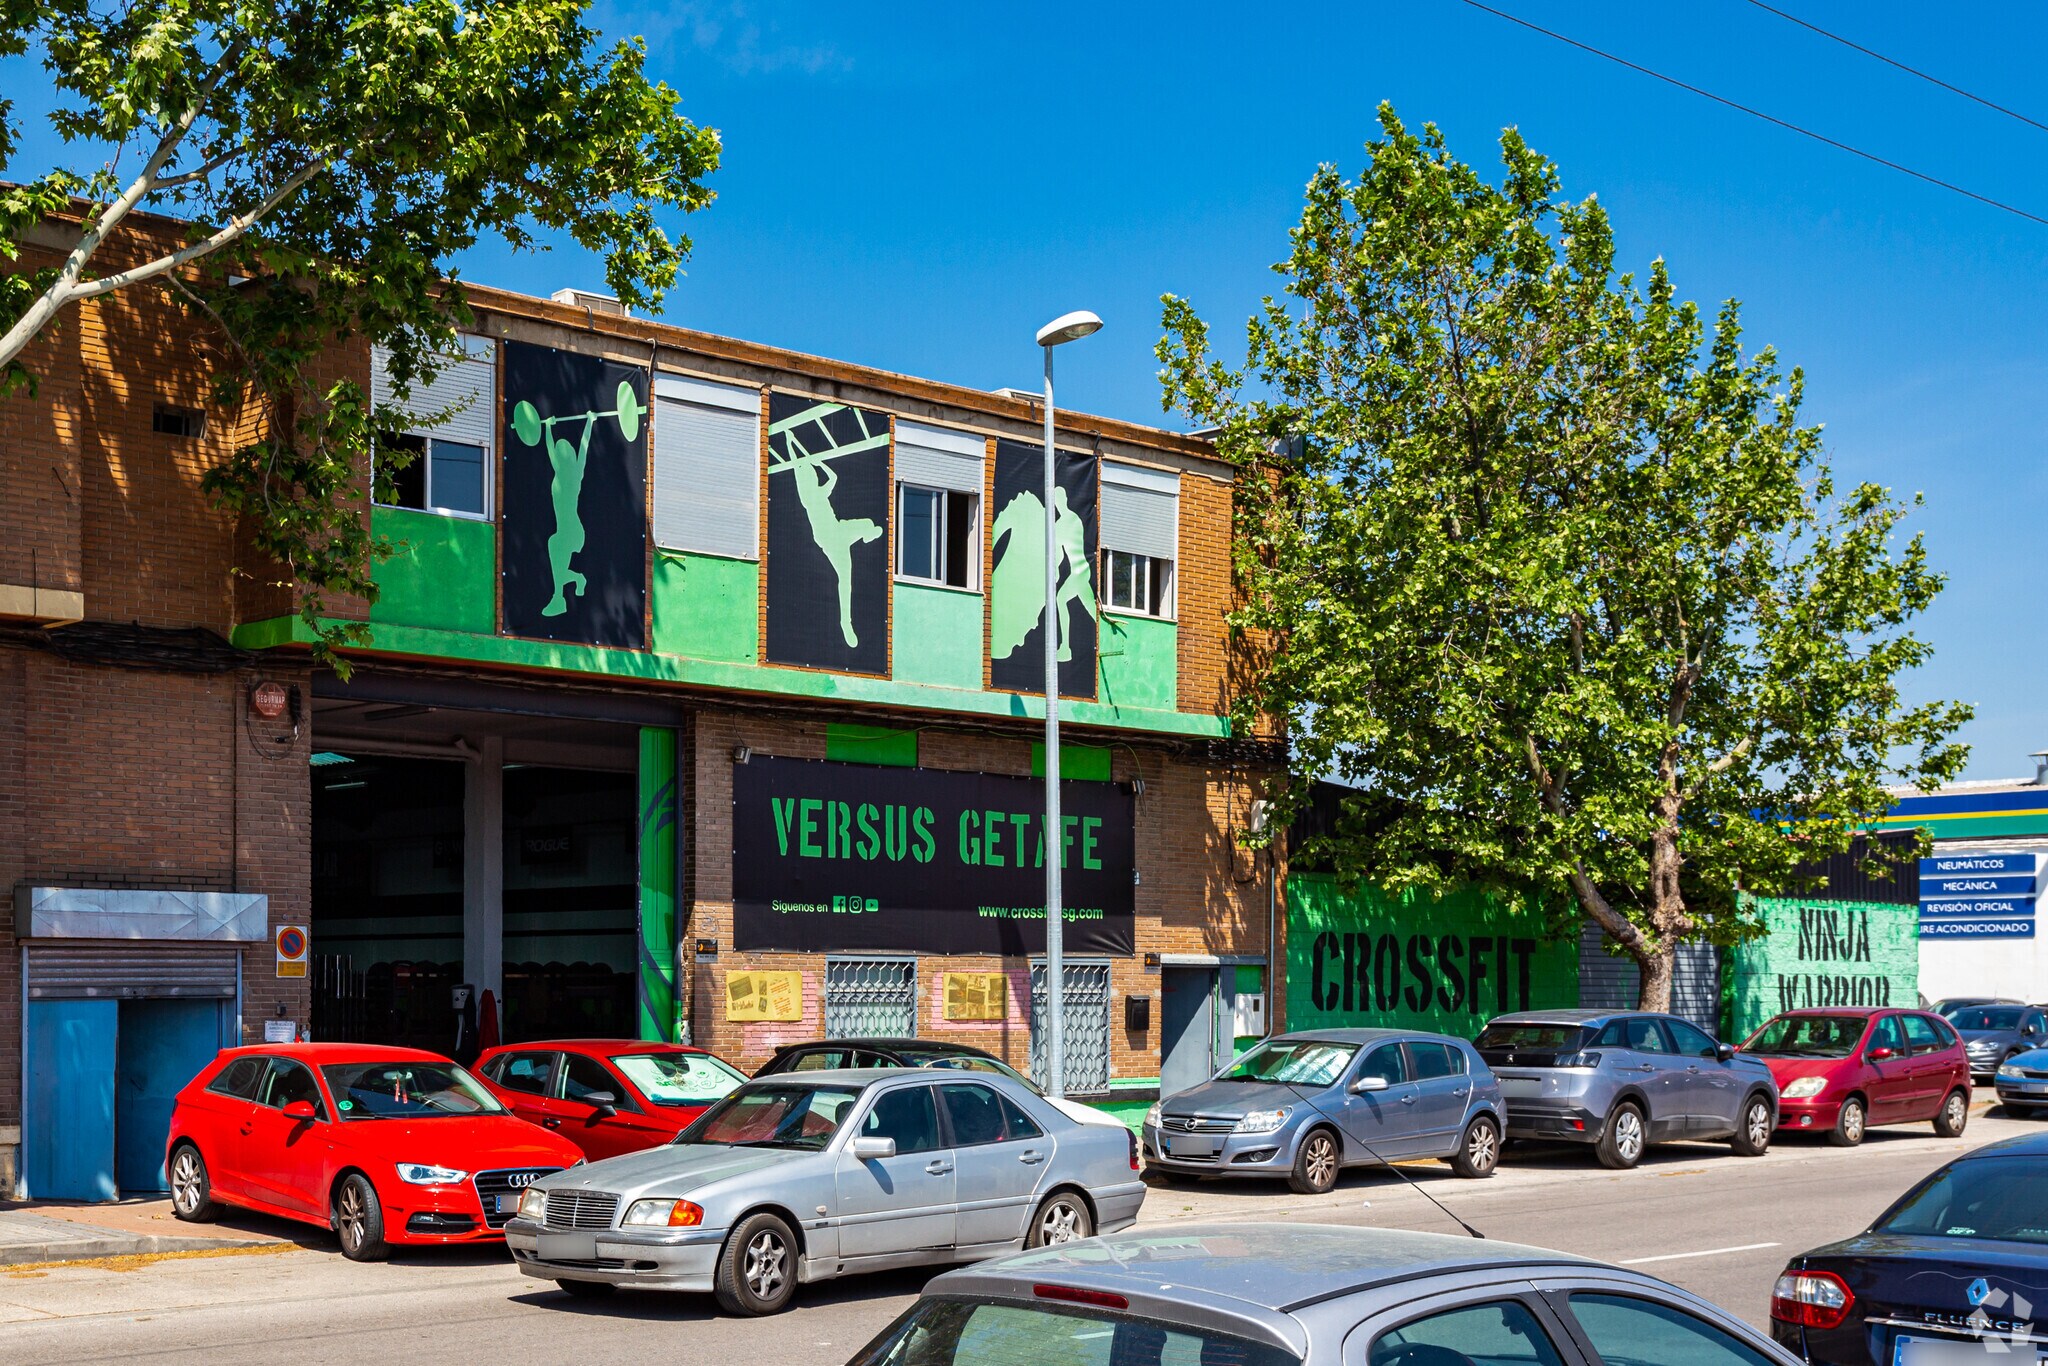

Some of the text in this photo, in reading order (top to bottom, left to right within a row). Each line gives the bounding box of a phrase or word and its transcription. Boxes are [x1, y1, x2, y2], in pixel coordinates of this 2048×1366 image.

[771, 797, 936, 863] VERSUS
[1936, 859, 2005, 871] NEUMÁTICOS
[1942, 879, 1998, 891] MECÁNICA
[816, 903, 829, 913] en
[1926, 901, 2014, 913] REVISIÓN OFICIAL
[1919, 922, 2030, 934] IRE ACONDICIONADO
[1798, 907, 1871, 962] NINJA
[1311, 931, 1537, 1016] CROSSFIT
[1924, 1312, 2025, 1333] FLUENCE
